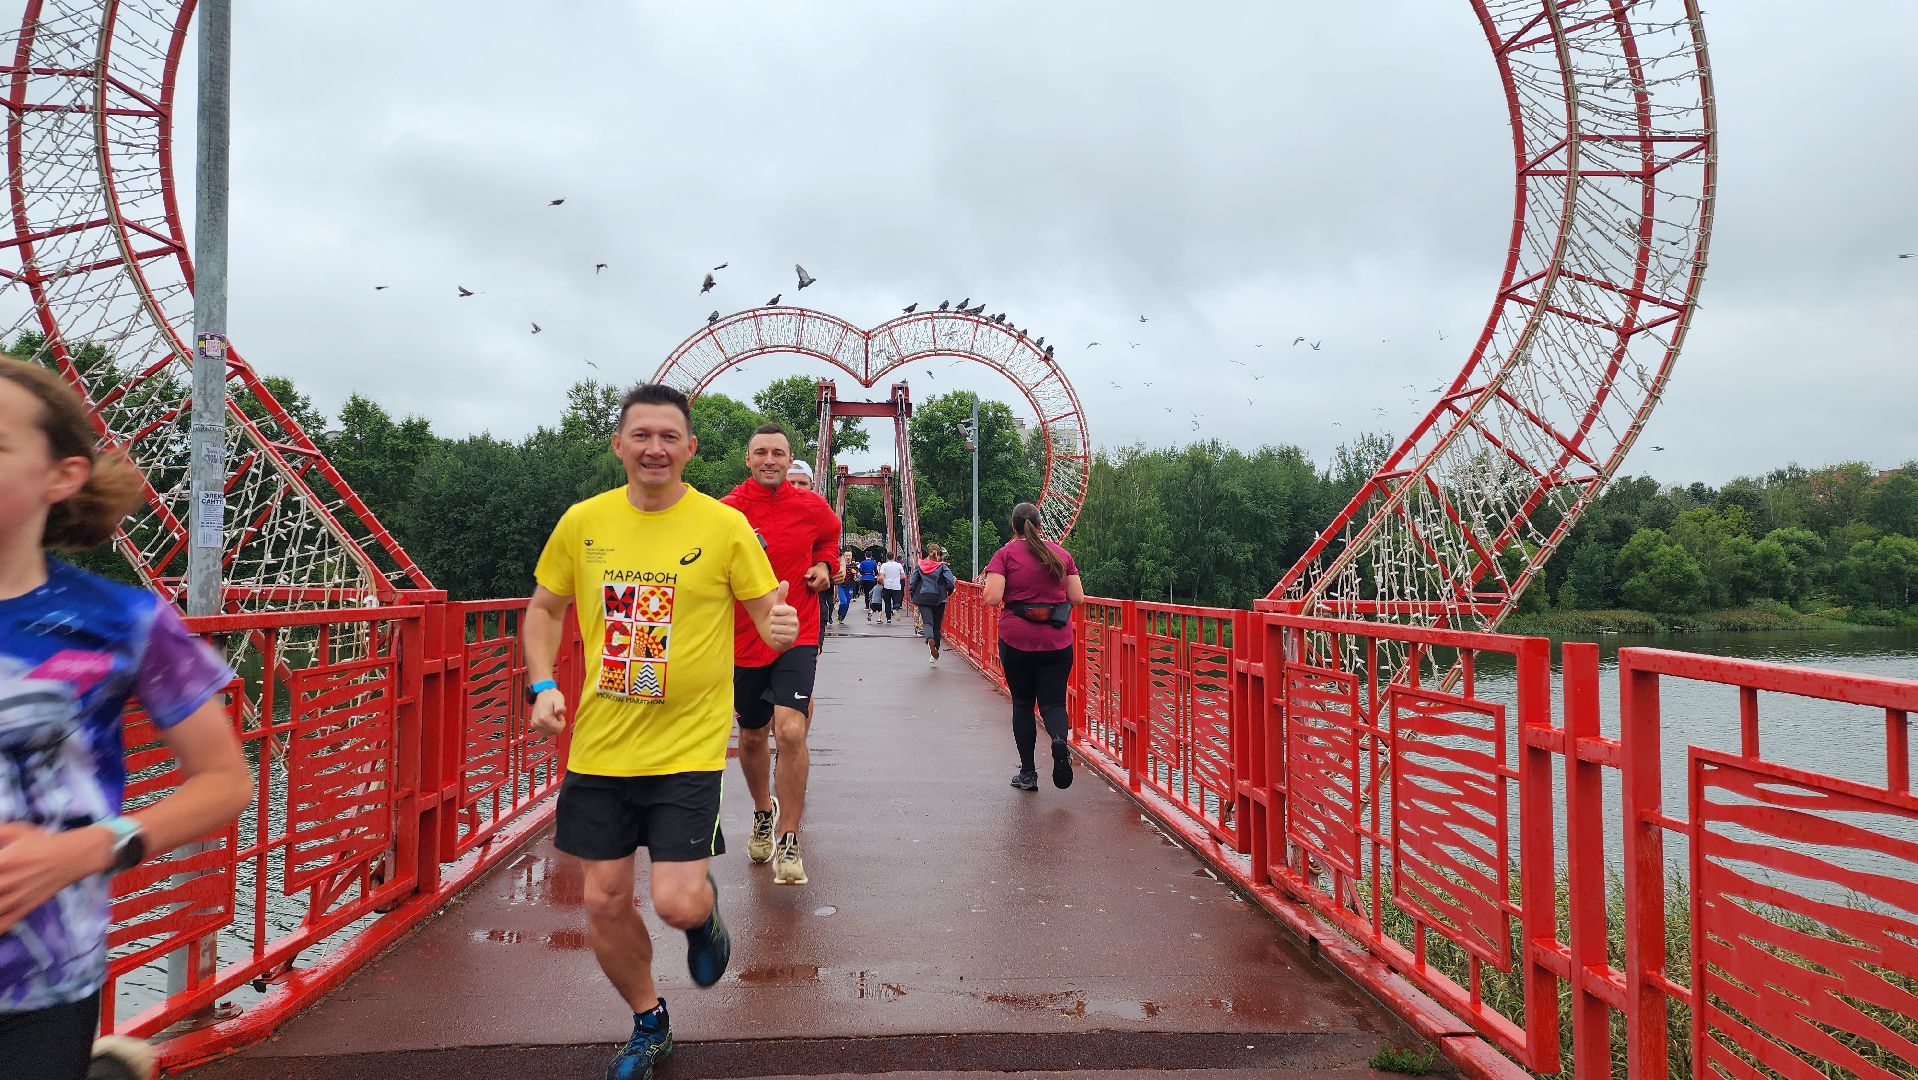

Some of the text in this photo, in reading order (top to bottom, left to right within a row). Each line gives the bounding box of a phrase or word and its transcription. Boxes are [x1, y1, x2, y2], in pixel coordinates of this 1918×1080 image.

[603, 569, 678, 585] МАРАФОН
[596, 692, 665, 705] MOSCOW MARATHON
